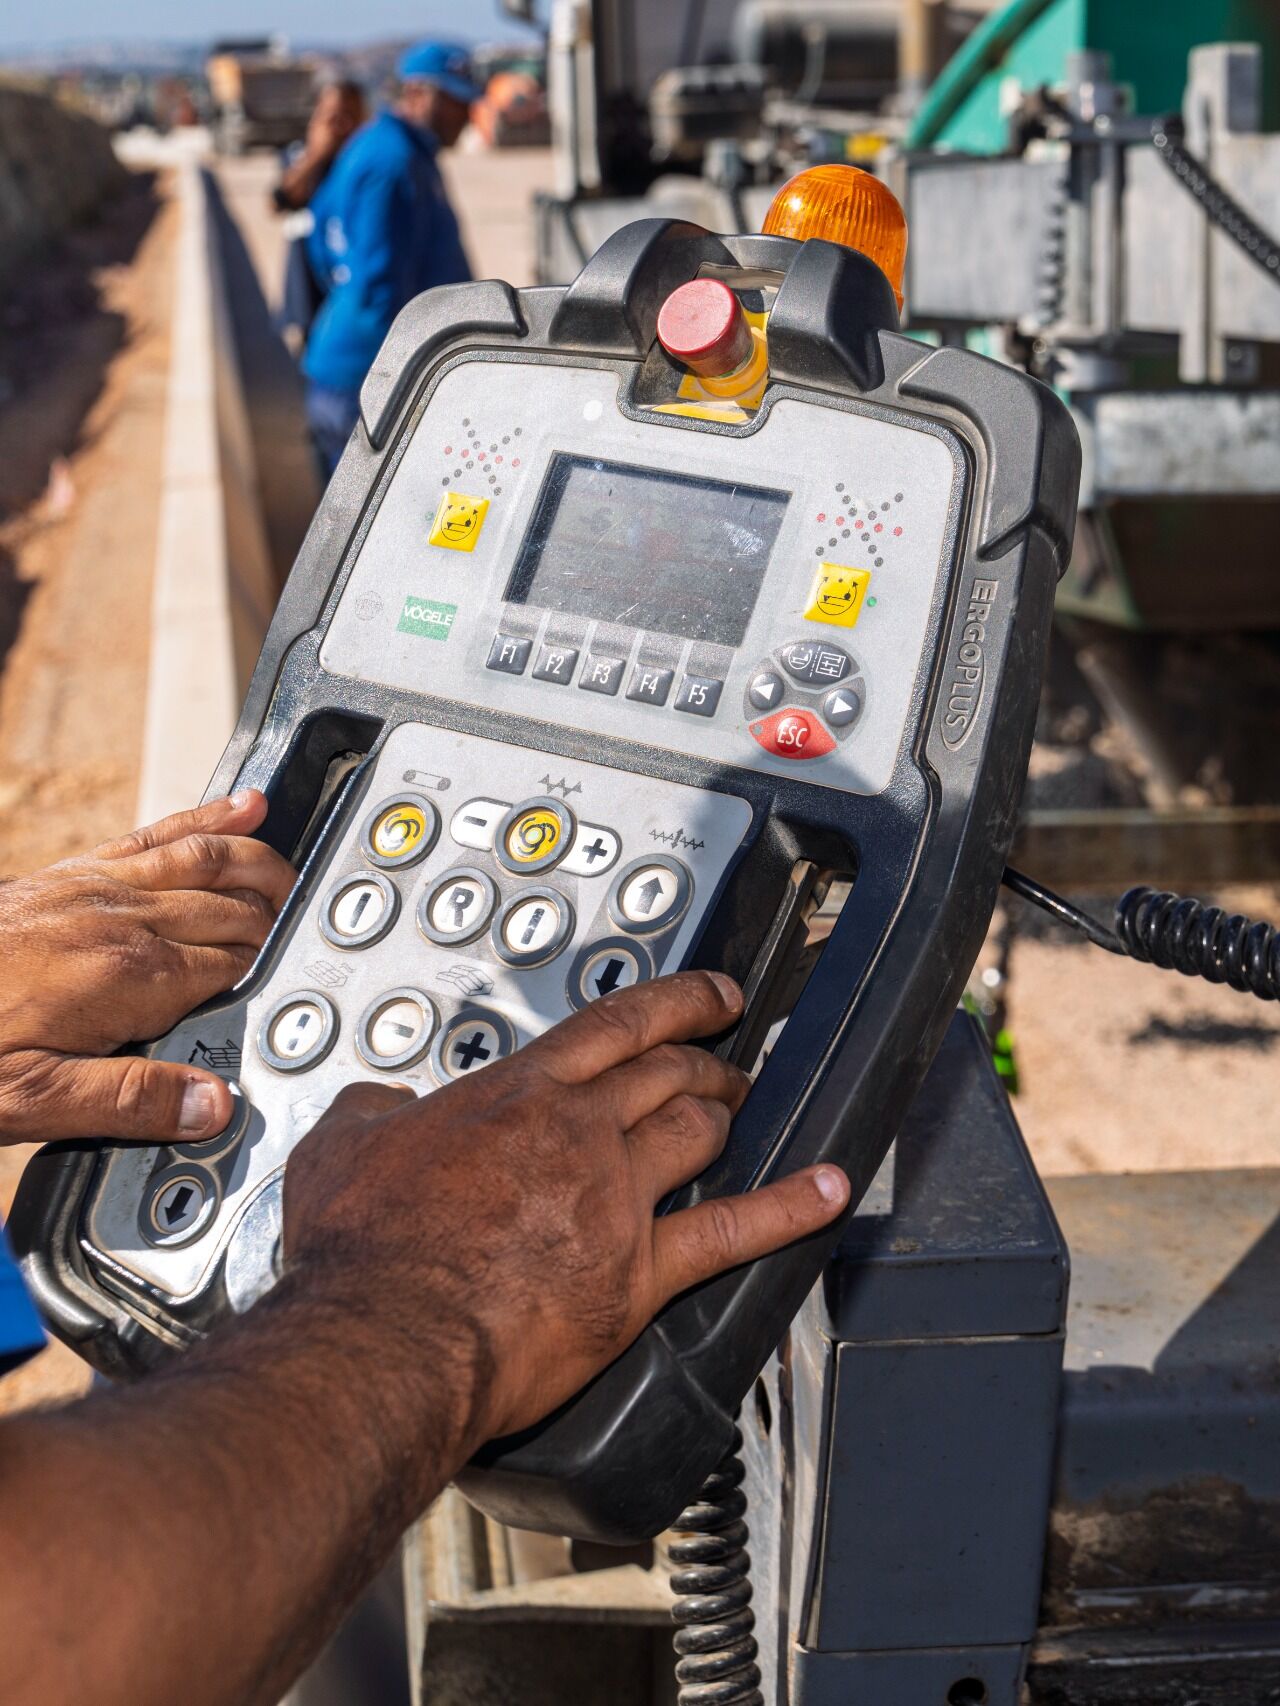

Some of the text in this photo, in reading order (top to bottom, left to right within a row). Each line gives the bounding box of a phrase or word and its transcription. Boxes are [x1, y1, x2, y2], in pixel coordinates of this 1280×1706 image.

[404, 605, 454, 626] VÖGELE
[499, 645, 517, 664] F1
[545, 654, 565, 675] F2
[944, 578, 999, 730] ERGOPLUS
[592, 663, 611, 684] F3
[639, 674, 658, 695] F4
[688, 684, 709, 705] F5
[777, 725, 808, 748] ESC
